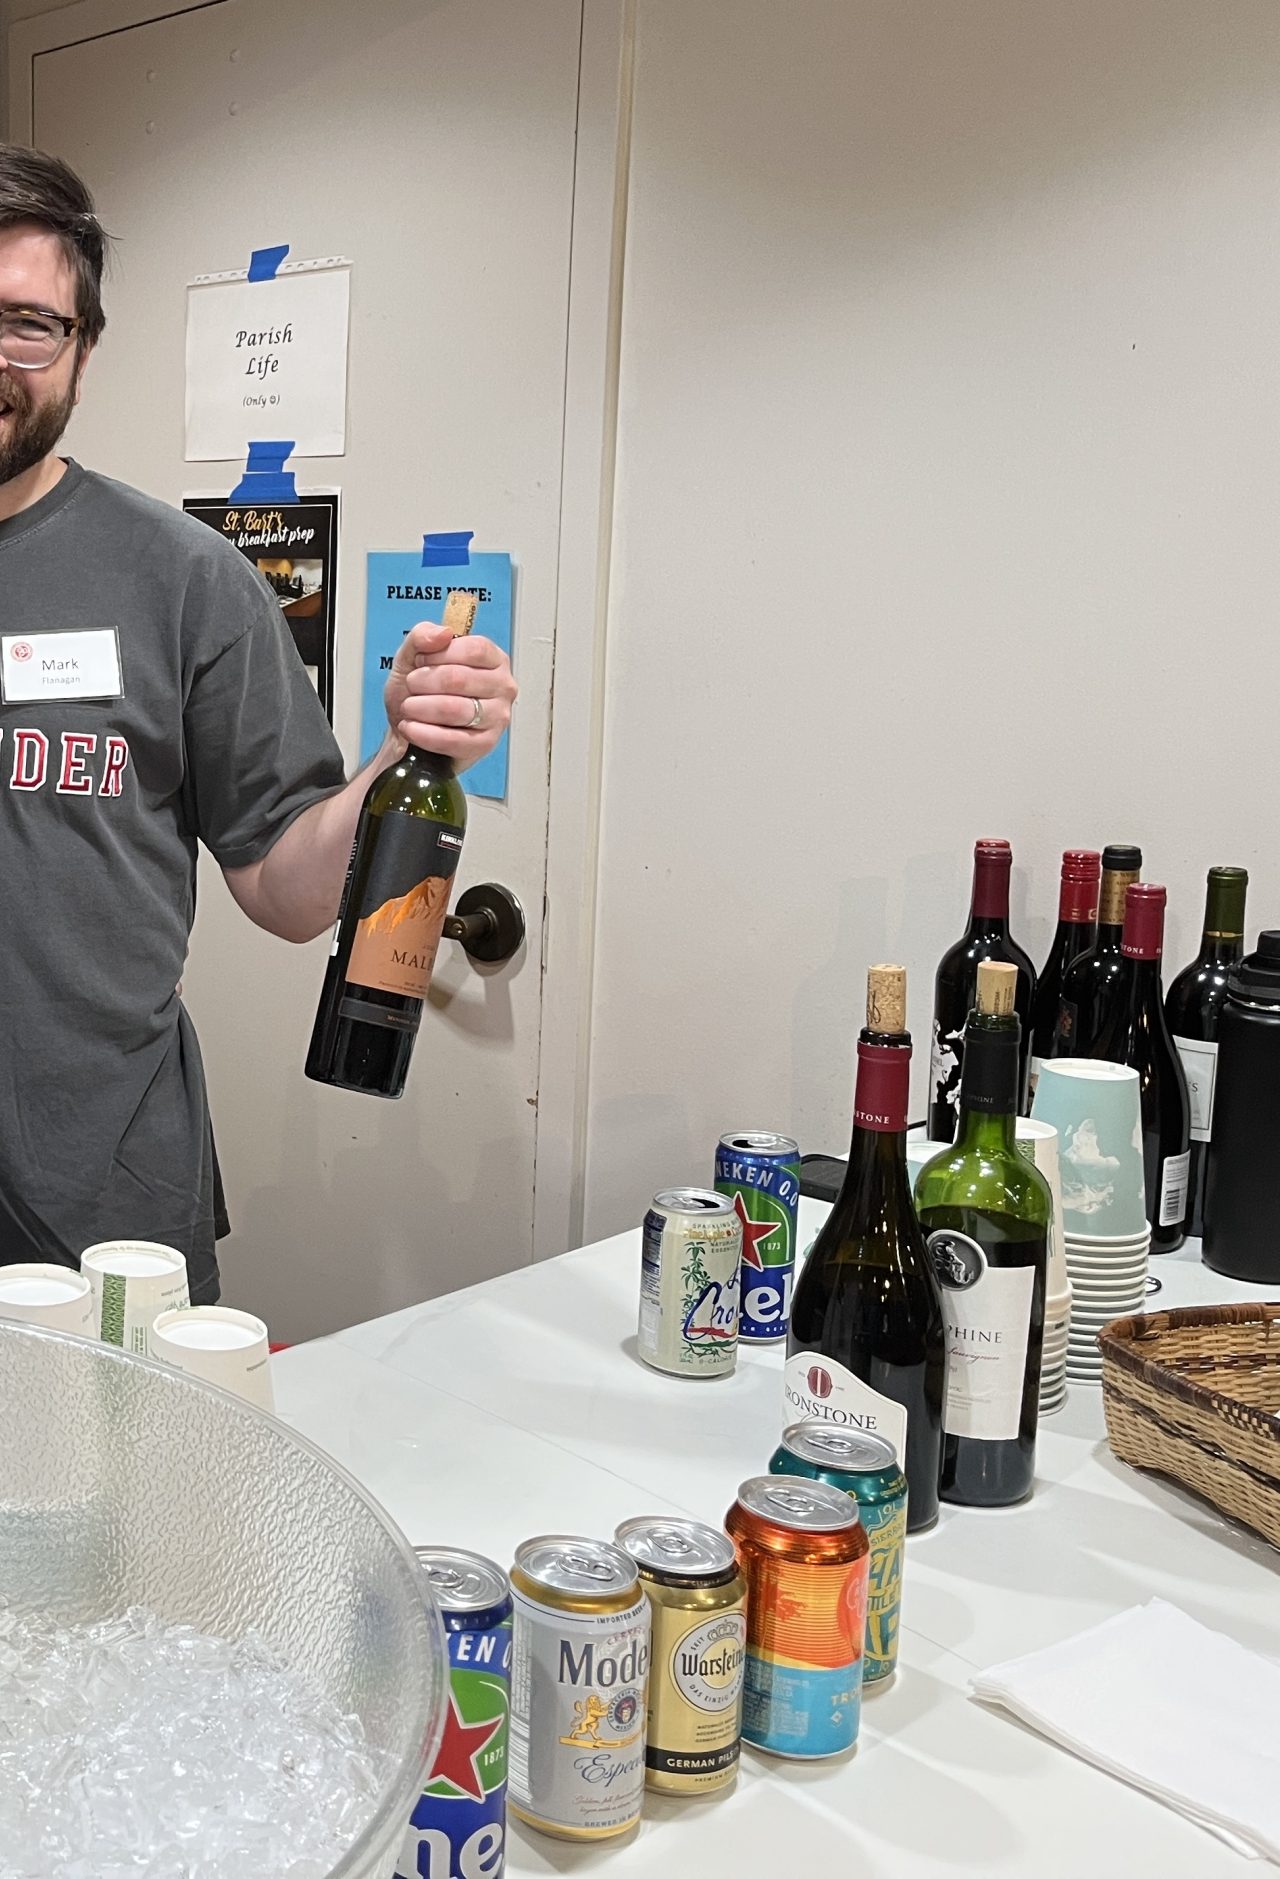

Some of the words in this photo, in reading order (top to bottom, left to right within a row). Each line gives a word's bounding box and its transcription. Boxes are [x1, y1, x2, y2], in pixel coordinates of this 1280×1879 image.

[234, 322, 294, 348] Parish
[244, 353, 280, 381] Life
[222, 510, 241, 532] St.
[243, 510, 285, 532] Bart's
[237, 526, 289, 548] breakfast
[287, 525, 315, 546] prep
[386, 585, 442, 601] PLEASE
[41, 657, 80, 671] Mark
[41, 676, 81, 685] Flanagan
[596, 1612, 632, 1625] IMPORTED
[690, 1636, 705, 1651] SEIT
[557, 1638, 649, 1688] Mode
[689, 1684, 703, 1697] DAS
[704, 1694, 729, 1704] EINZIG
[666, 1757, 716, 1769] GERMAN
